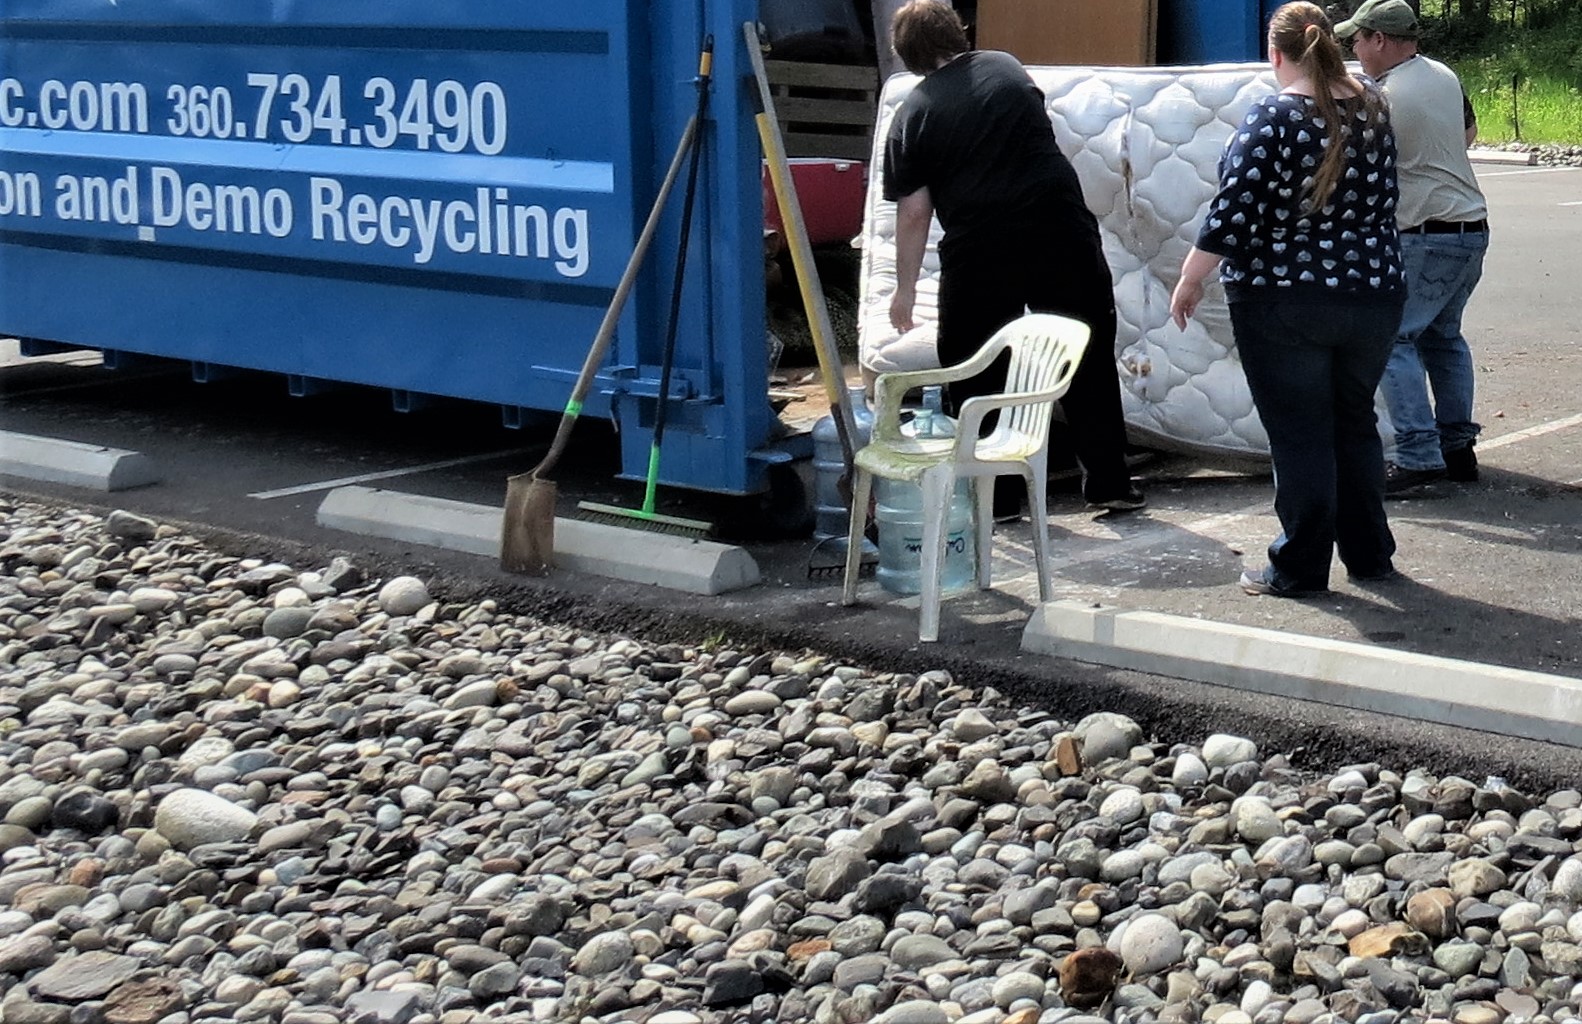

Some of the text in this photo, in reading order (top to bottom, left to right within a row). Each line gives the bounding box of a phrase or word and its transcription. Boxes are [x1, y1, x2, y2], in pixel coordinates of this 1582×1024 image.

[0, 73, 507, 156] c.com 360.734.3490
[55, 166, 140, 225] and
[151, 167, 294, 238] Demo
[310, 177, 590, 278] Recycling
